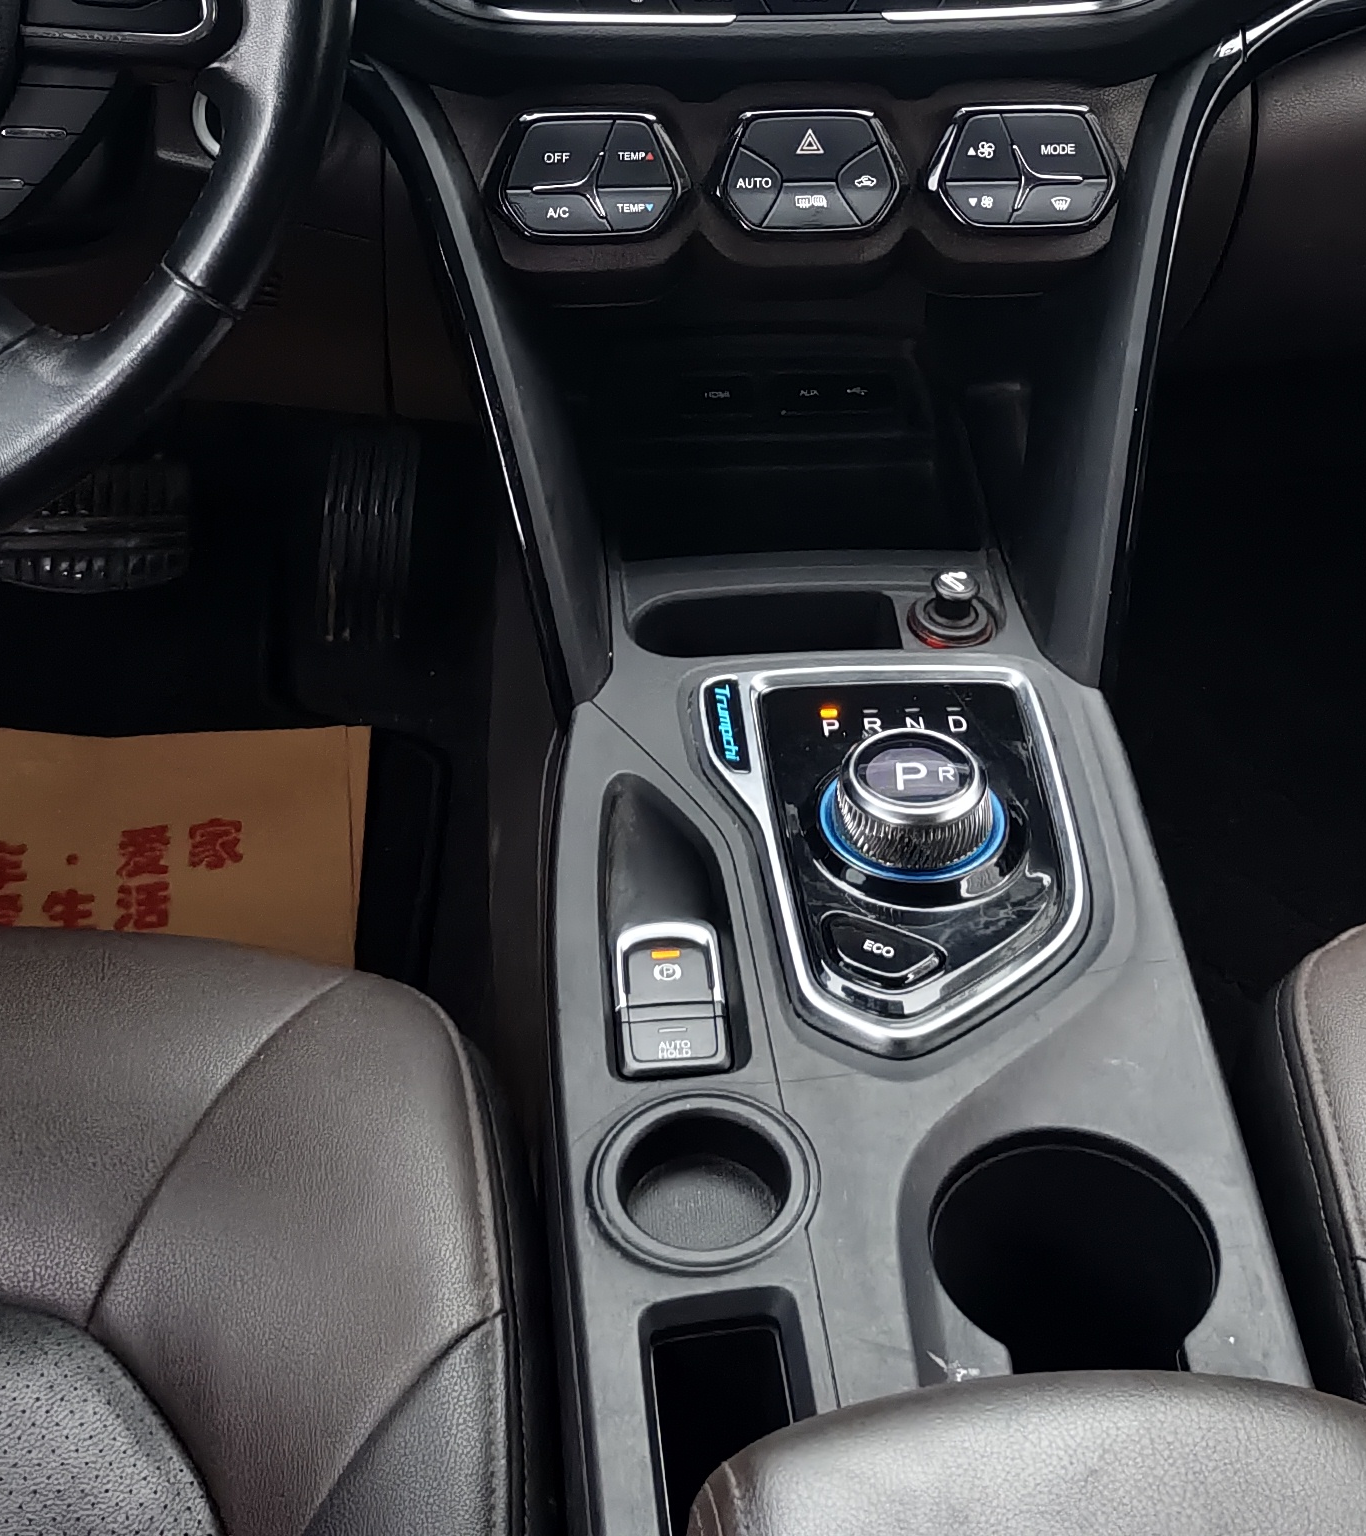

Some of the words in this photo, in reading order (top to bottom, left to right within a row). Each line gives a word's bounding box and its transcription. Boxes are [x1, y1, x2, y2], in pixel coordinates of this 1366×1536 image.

[617, 151, 646, 161] TEMP
[1040, 144, 1076, 156] MODE
[544, 152, 571, 164] OFF
[736, 177, 772, 189] AUTO
[546, 207, 570, 219] A/C
[616, 203, 645, 213] TEMP
[713, 684, 740, 763] Trumpchi
[822, 718, 840, 737] P
[863, 716, 884, 733] R
[905, 715, 925, 730] N
[948, 715, 968, 733] D
[895, 761, 928, 791] P
[938, 766, 955, 783] R
[862, 939, 895, 958] ECO
[658, 1040, 691, 1050] AUTO
[658, 1048, 692, 1059] HOLD
